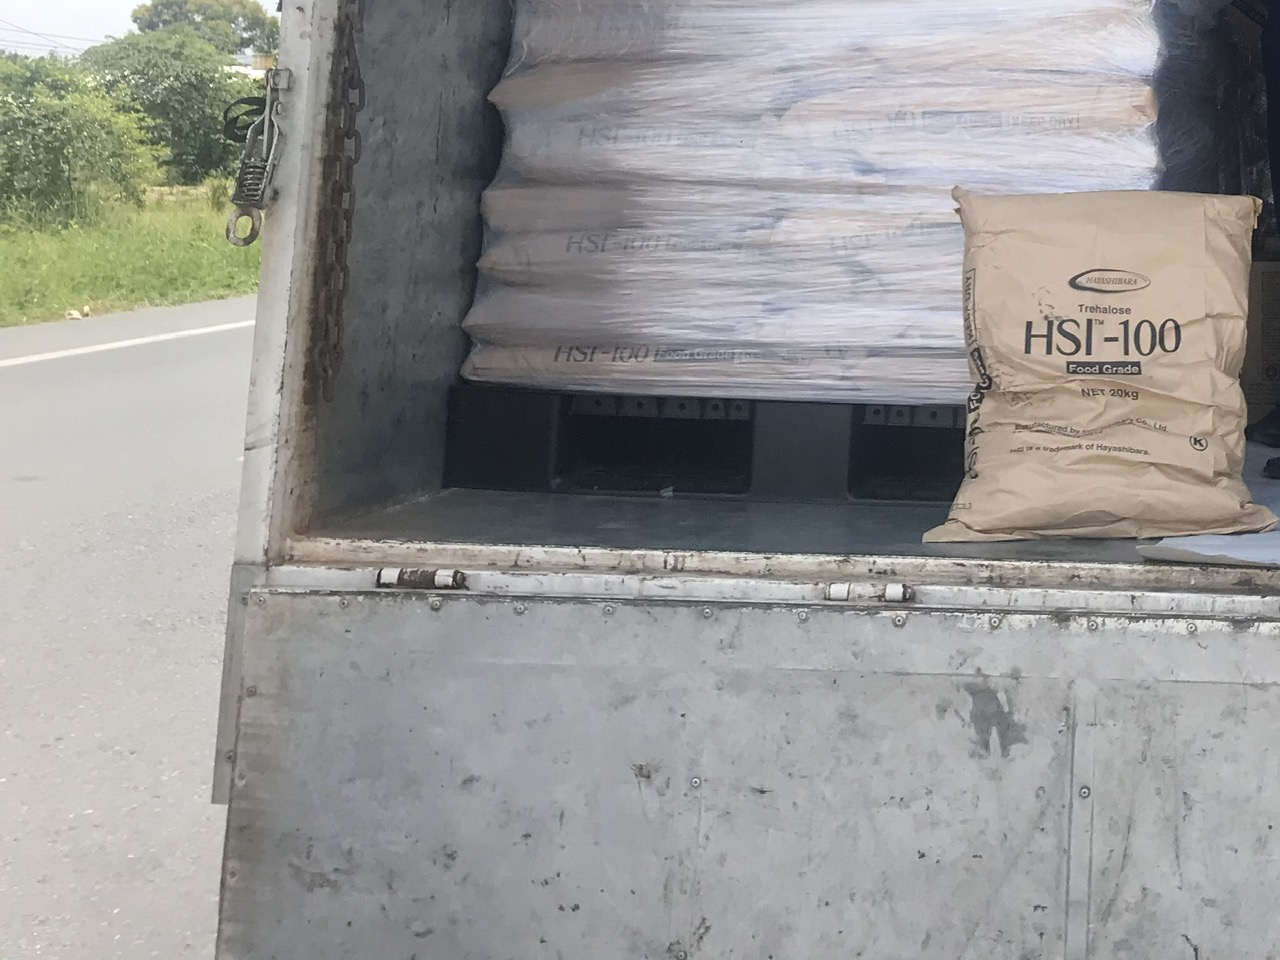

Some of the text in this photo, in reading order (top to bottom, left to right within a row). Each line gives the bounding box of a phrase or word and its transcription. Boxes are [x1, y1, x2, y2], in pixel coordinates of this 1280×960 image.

[1086, 276, 1138, 286] HAYASHIBARA
[1078, 304, 1132, 315] Trehalose
[1068, 364, 1140, 374] Food Grade
[1081, 388, 1139, 400] NET 20kg
[1069, 427, 1080, 435] by
[1153, 422, 1169, 432] Ltd.
[1042, 442, 1084, 453] trademark
[1085, 442, 1095, 451] of
[1096, 442, 1152, 456] Hayashibara.
